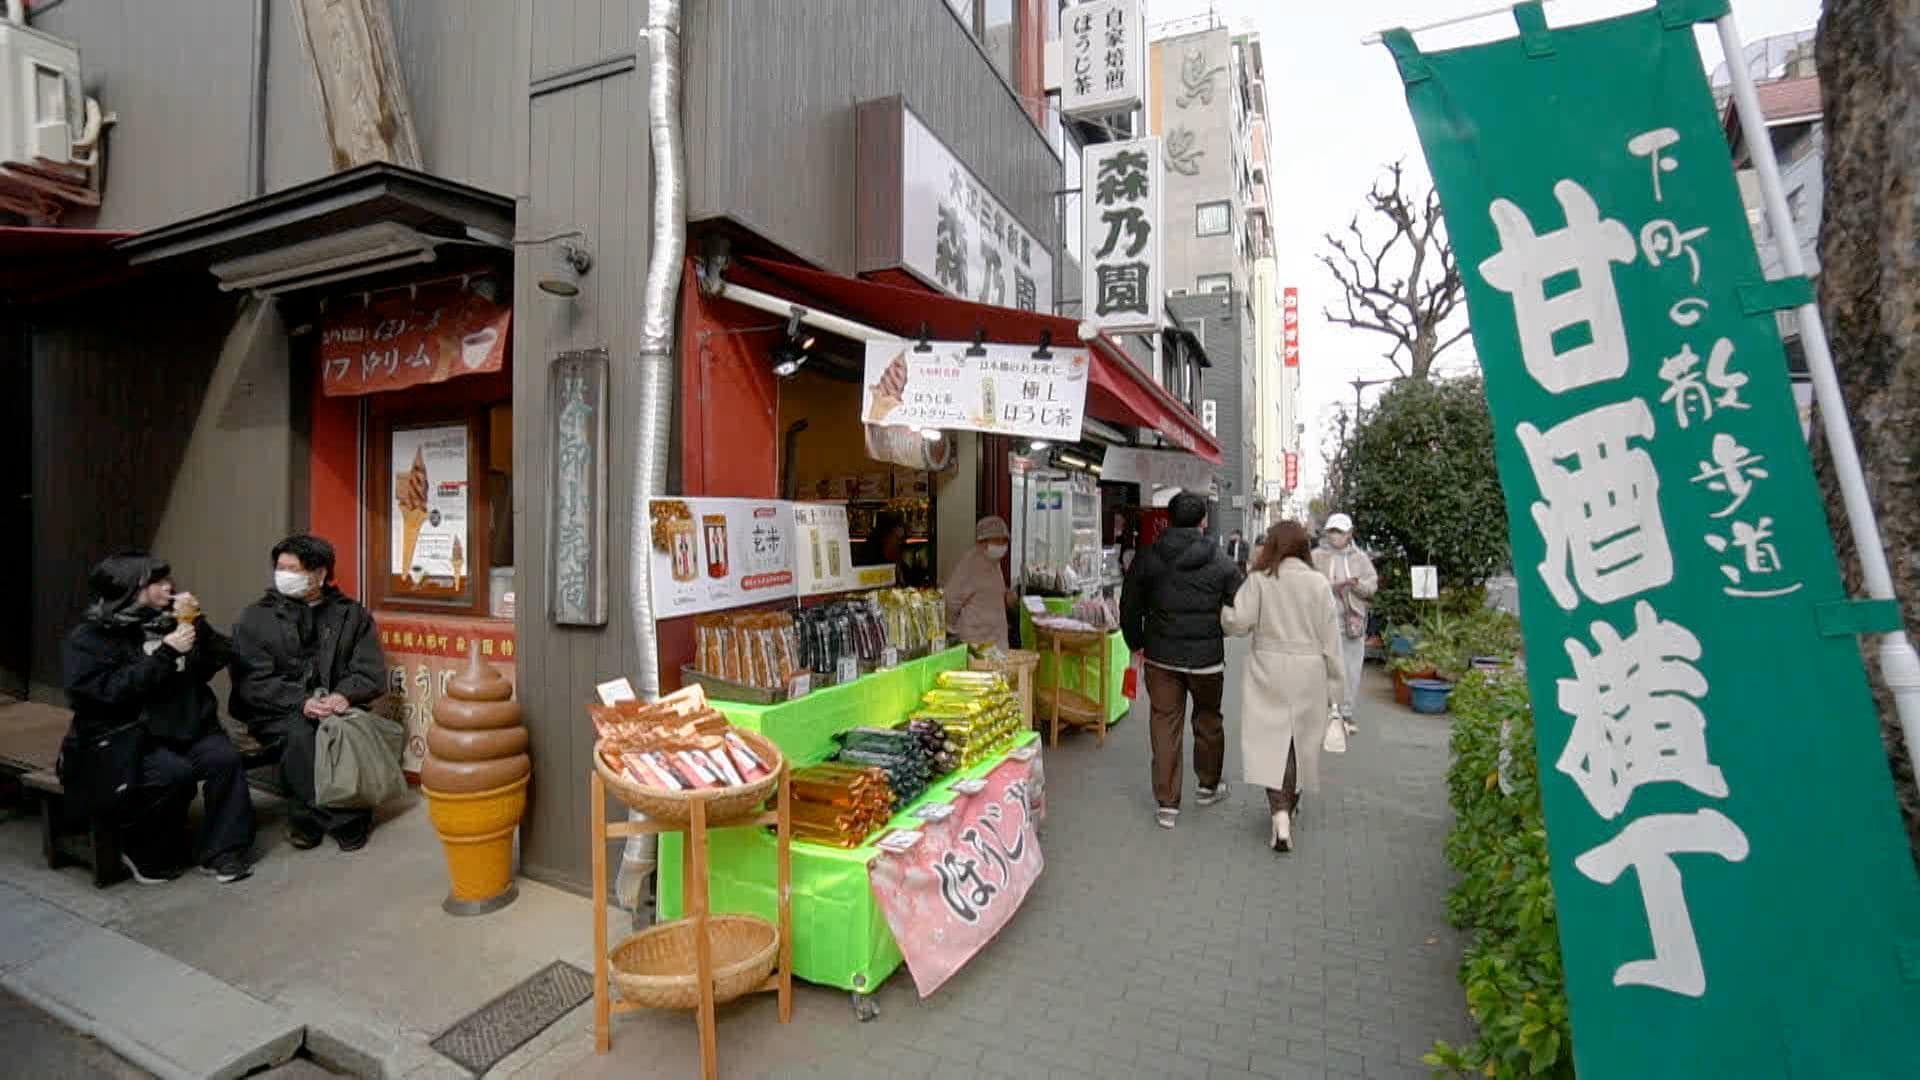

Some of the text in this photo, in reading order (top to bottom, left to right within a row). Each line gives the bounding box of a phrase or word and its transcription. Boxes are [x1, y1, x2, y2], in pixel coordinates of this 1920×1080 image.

[1073, 12, 1094, 96] ほうじ茶
[936, 203, 1036, 313] 森乃園
[1095, 150, 1151, 317] 森乃園
[1022, 380, 1059, 402] 極上
[1627, 126, 1803, 598] 下町の散歩道
[1003, 403, 1073, 428] ほうじ茶
[1478, 178, 1750, 998] 甘酒横丁
[382, 630, 448, 652] 日本橋人形町
[455, 635, 494, 656] 森園
